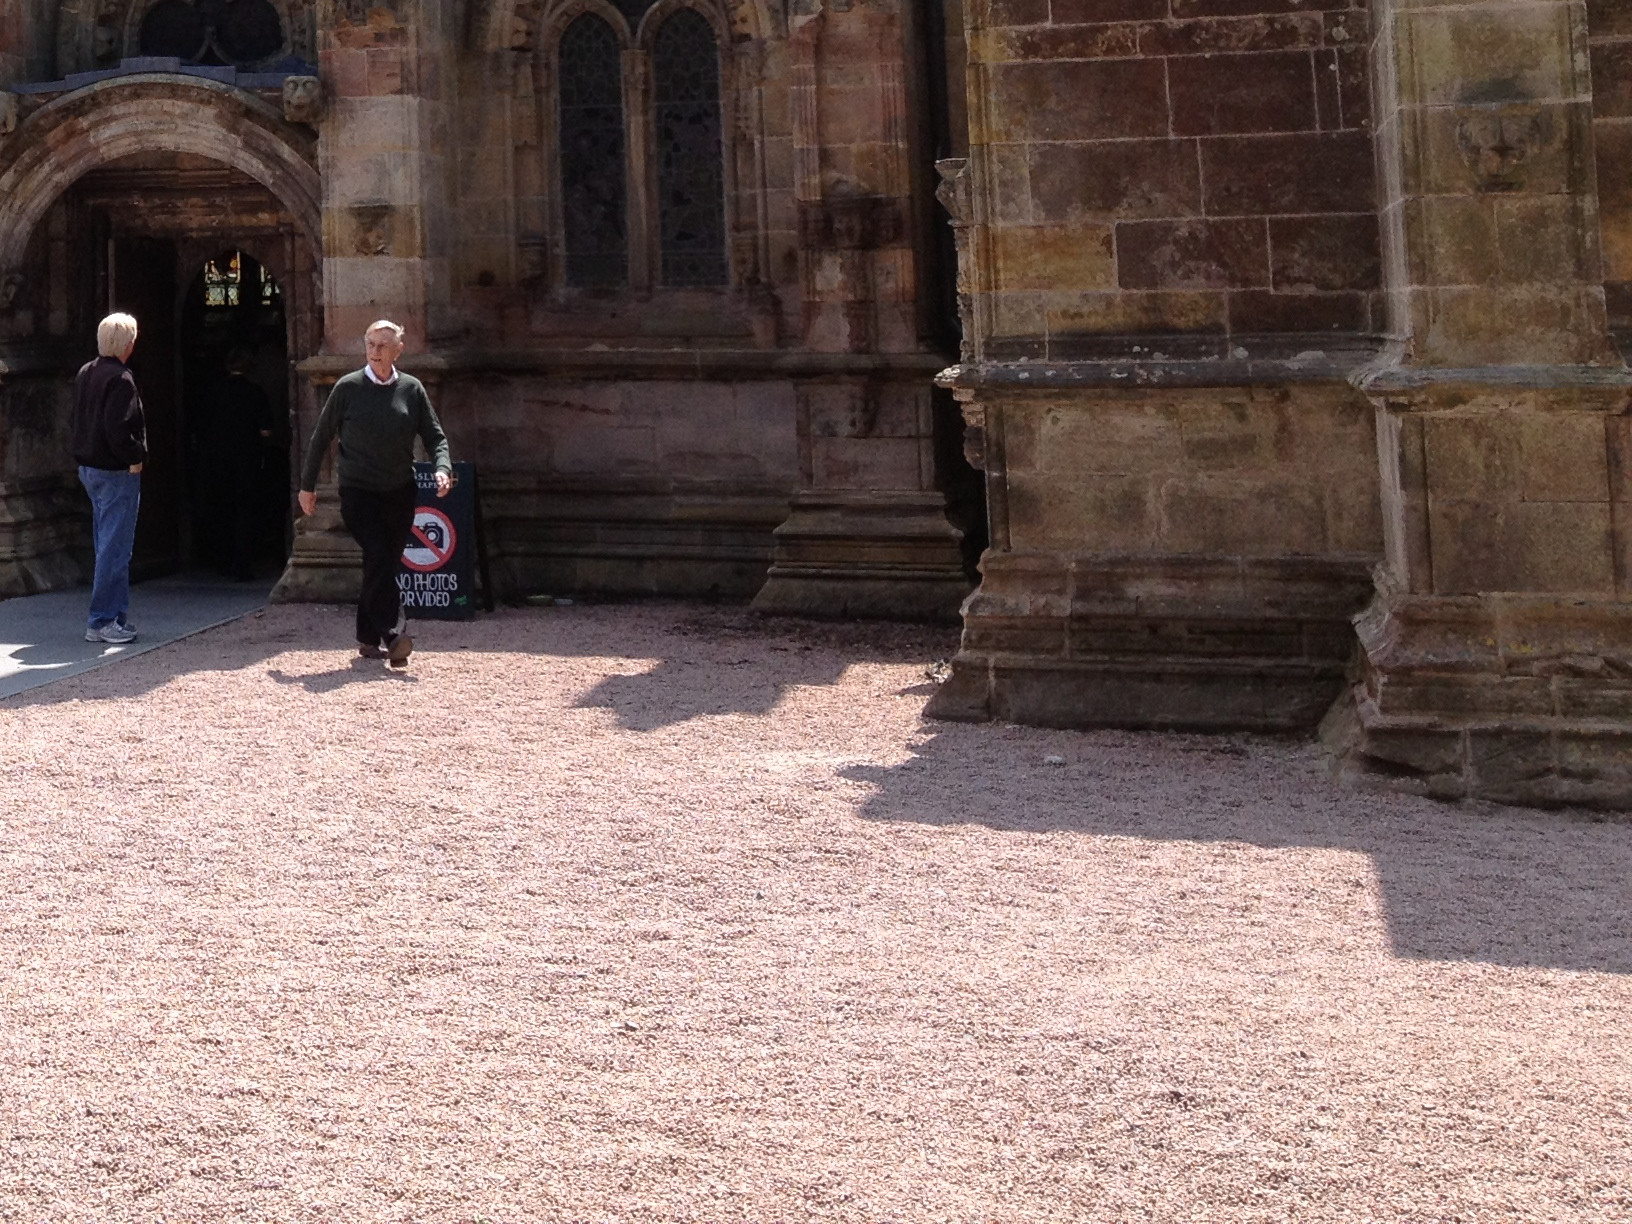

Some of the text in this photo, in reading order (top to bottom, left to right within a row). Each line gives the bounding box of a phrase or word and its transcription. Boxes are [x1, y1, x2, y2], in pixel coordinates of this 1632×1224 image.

[395, 573, 458, 591] NO PHOTOS
[399, 590, 416, 607] OR
[415, 590, 450, 607] VIDEO
